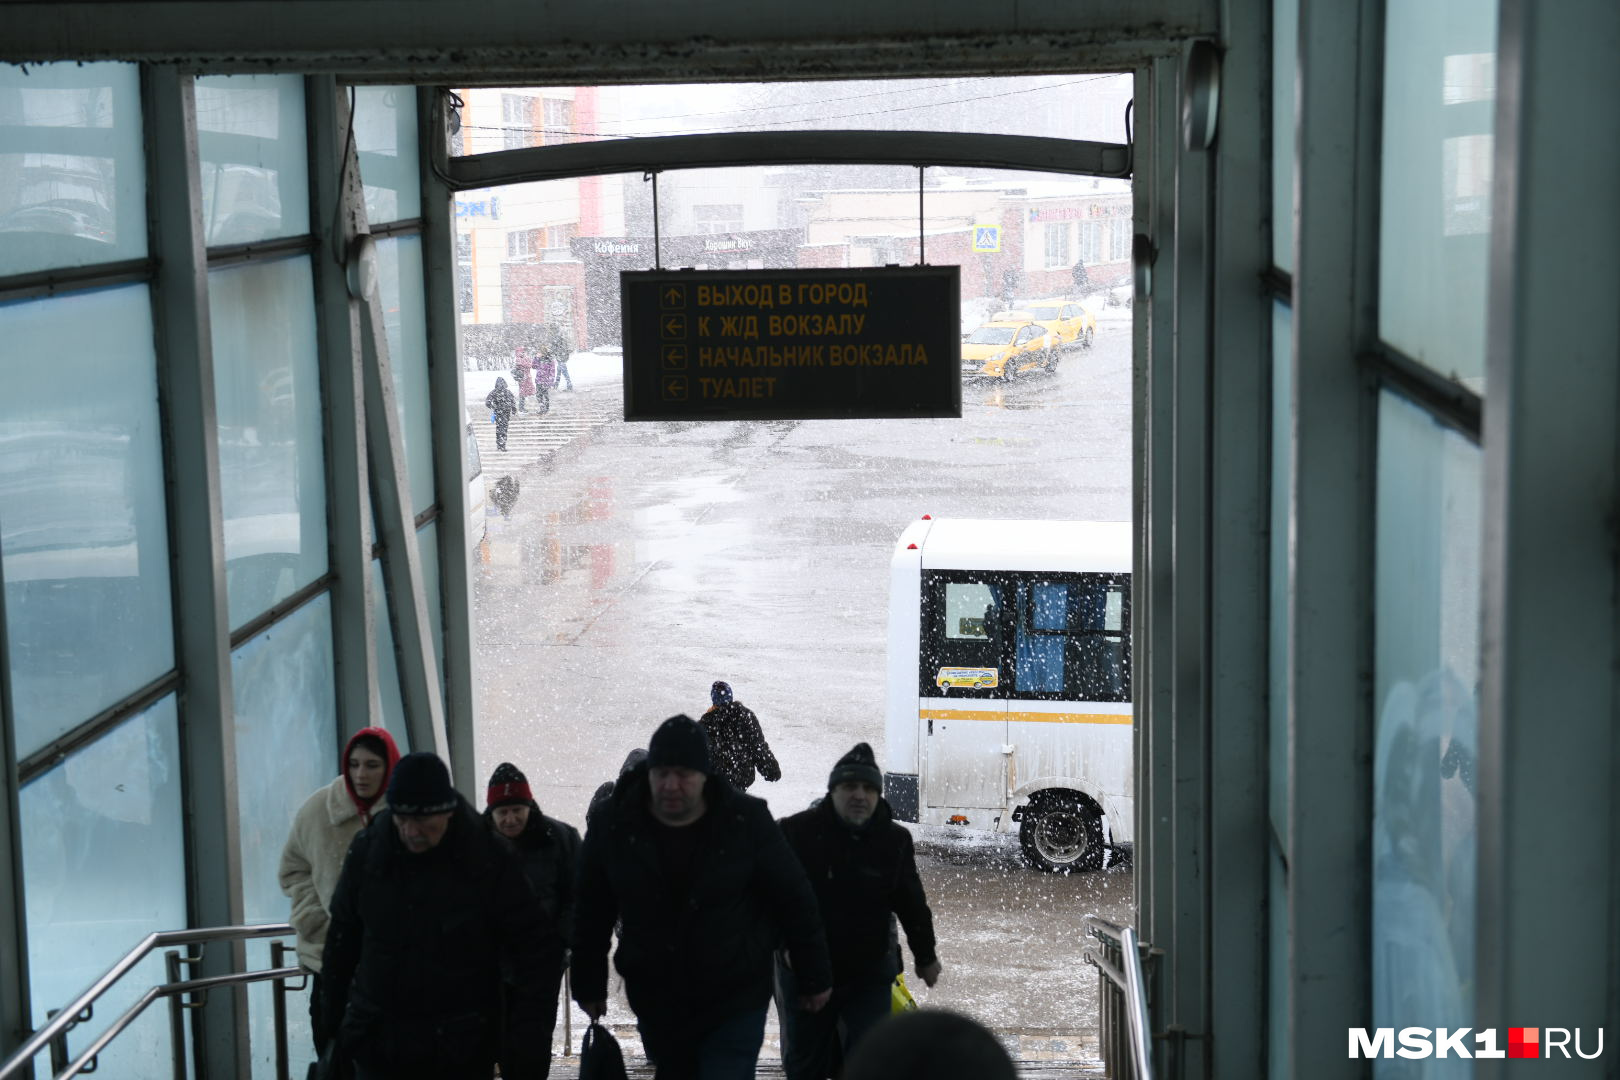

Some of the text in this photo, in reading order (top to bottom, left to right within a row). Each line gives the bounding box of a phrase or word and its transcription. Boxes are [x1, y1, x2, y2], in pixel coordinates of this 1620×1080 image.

[697, 283, 869, 309] ВЫХОД В ГОРОД
[698, 314, 867, 340] К Ж/Д ВОКЗАЛУ
[699, 343, 930, 368] НАЧАЛЬНИК ВОКЗАЛА
[699, 377, 777, 399] ТУАЛЕТ
